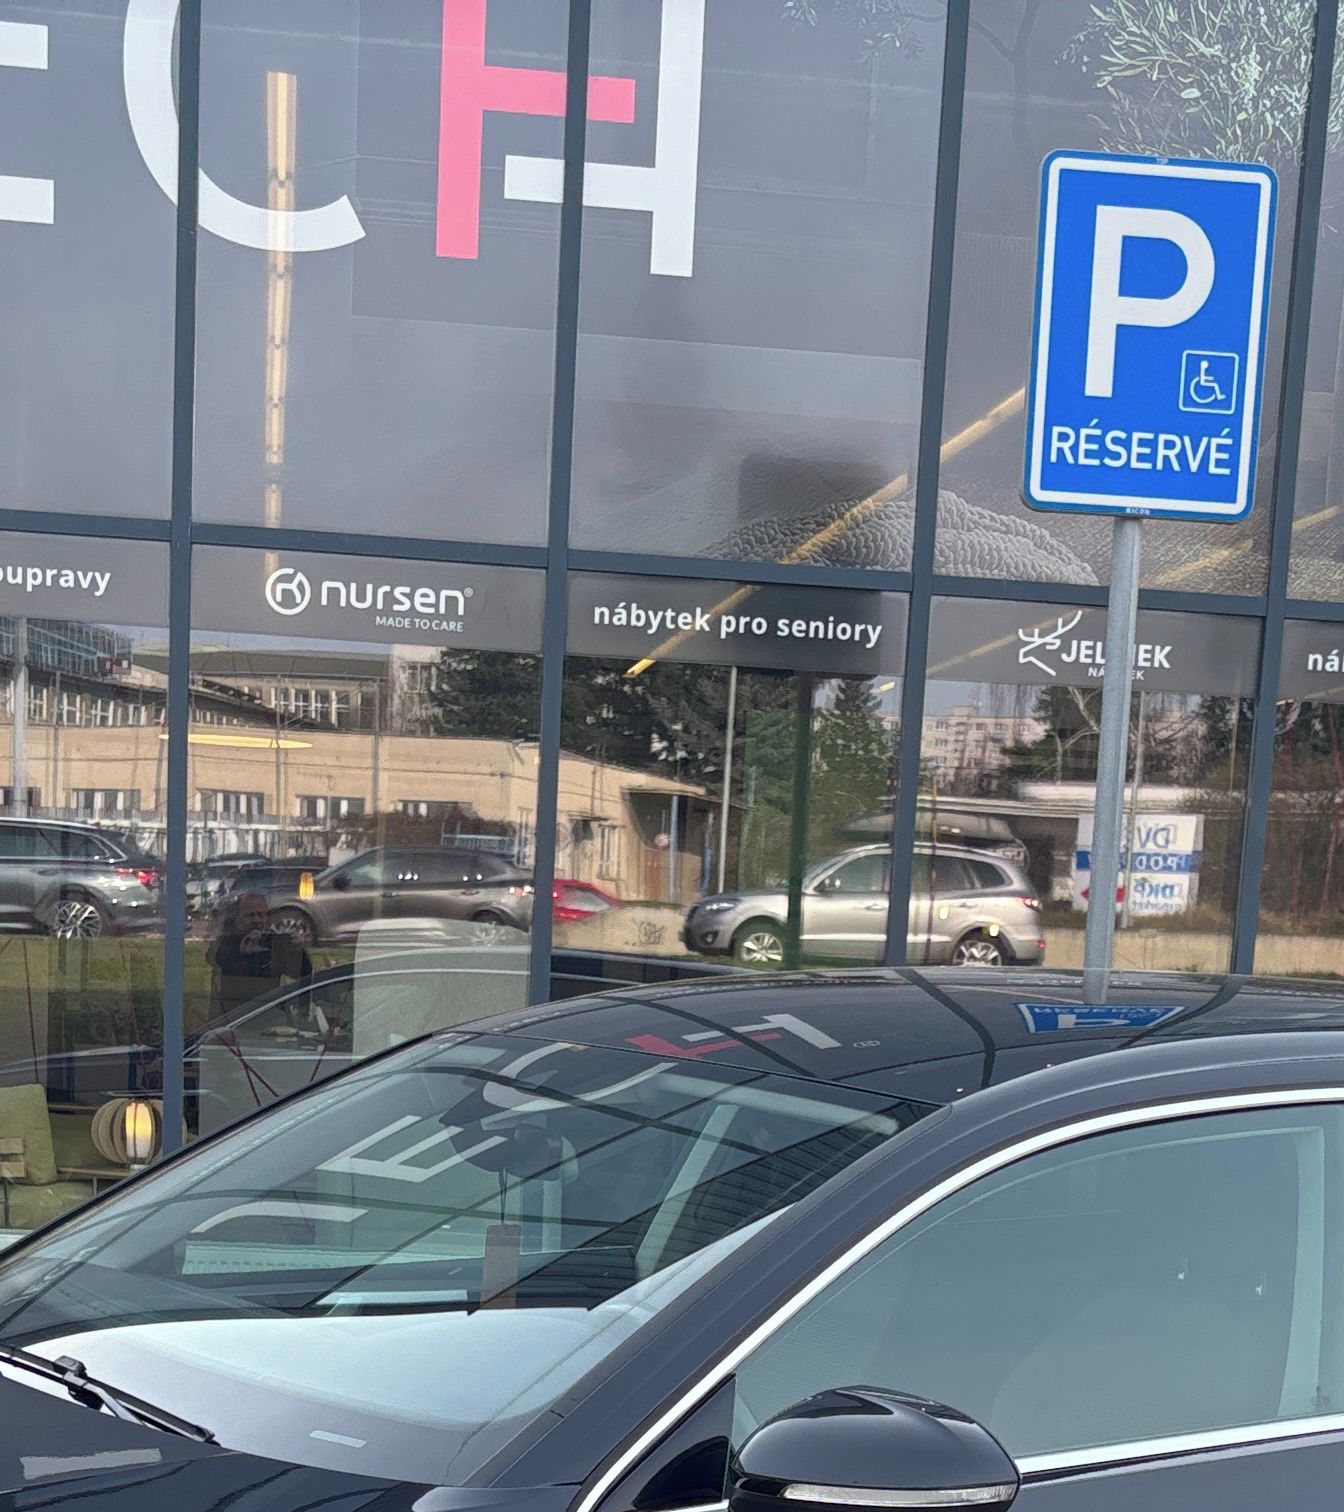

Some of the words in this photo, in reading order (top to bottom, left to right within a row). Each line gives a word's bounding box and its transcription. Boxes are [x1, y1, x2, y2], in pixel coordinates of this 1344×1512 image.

[1084, 204, 1216, 398] P
[1049, 418, 1233, 475] RÉSERVÉ
[320, 580, 466, 616] nursen
[375, 615, 412, 629] MADE
[414, 618, 430, 630] TO
[431, 619, 465, 633] CARE
[593, 602, 711, 634] nábytek
[719, 614, 768, 639] pro
[776, 616, 883, 649] seniory
[1061, 639, 1173, 669] JELEK
